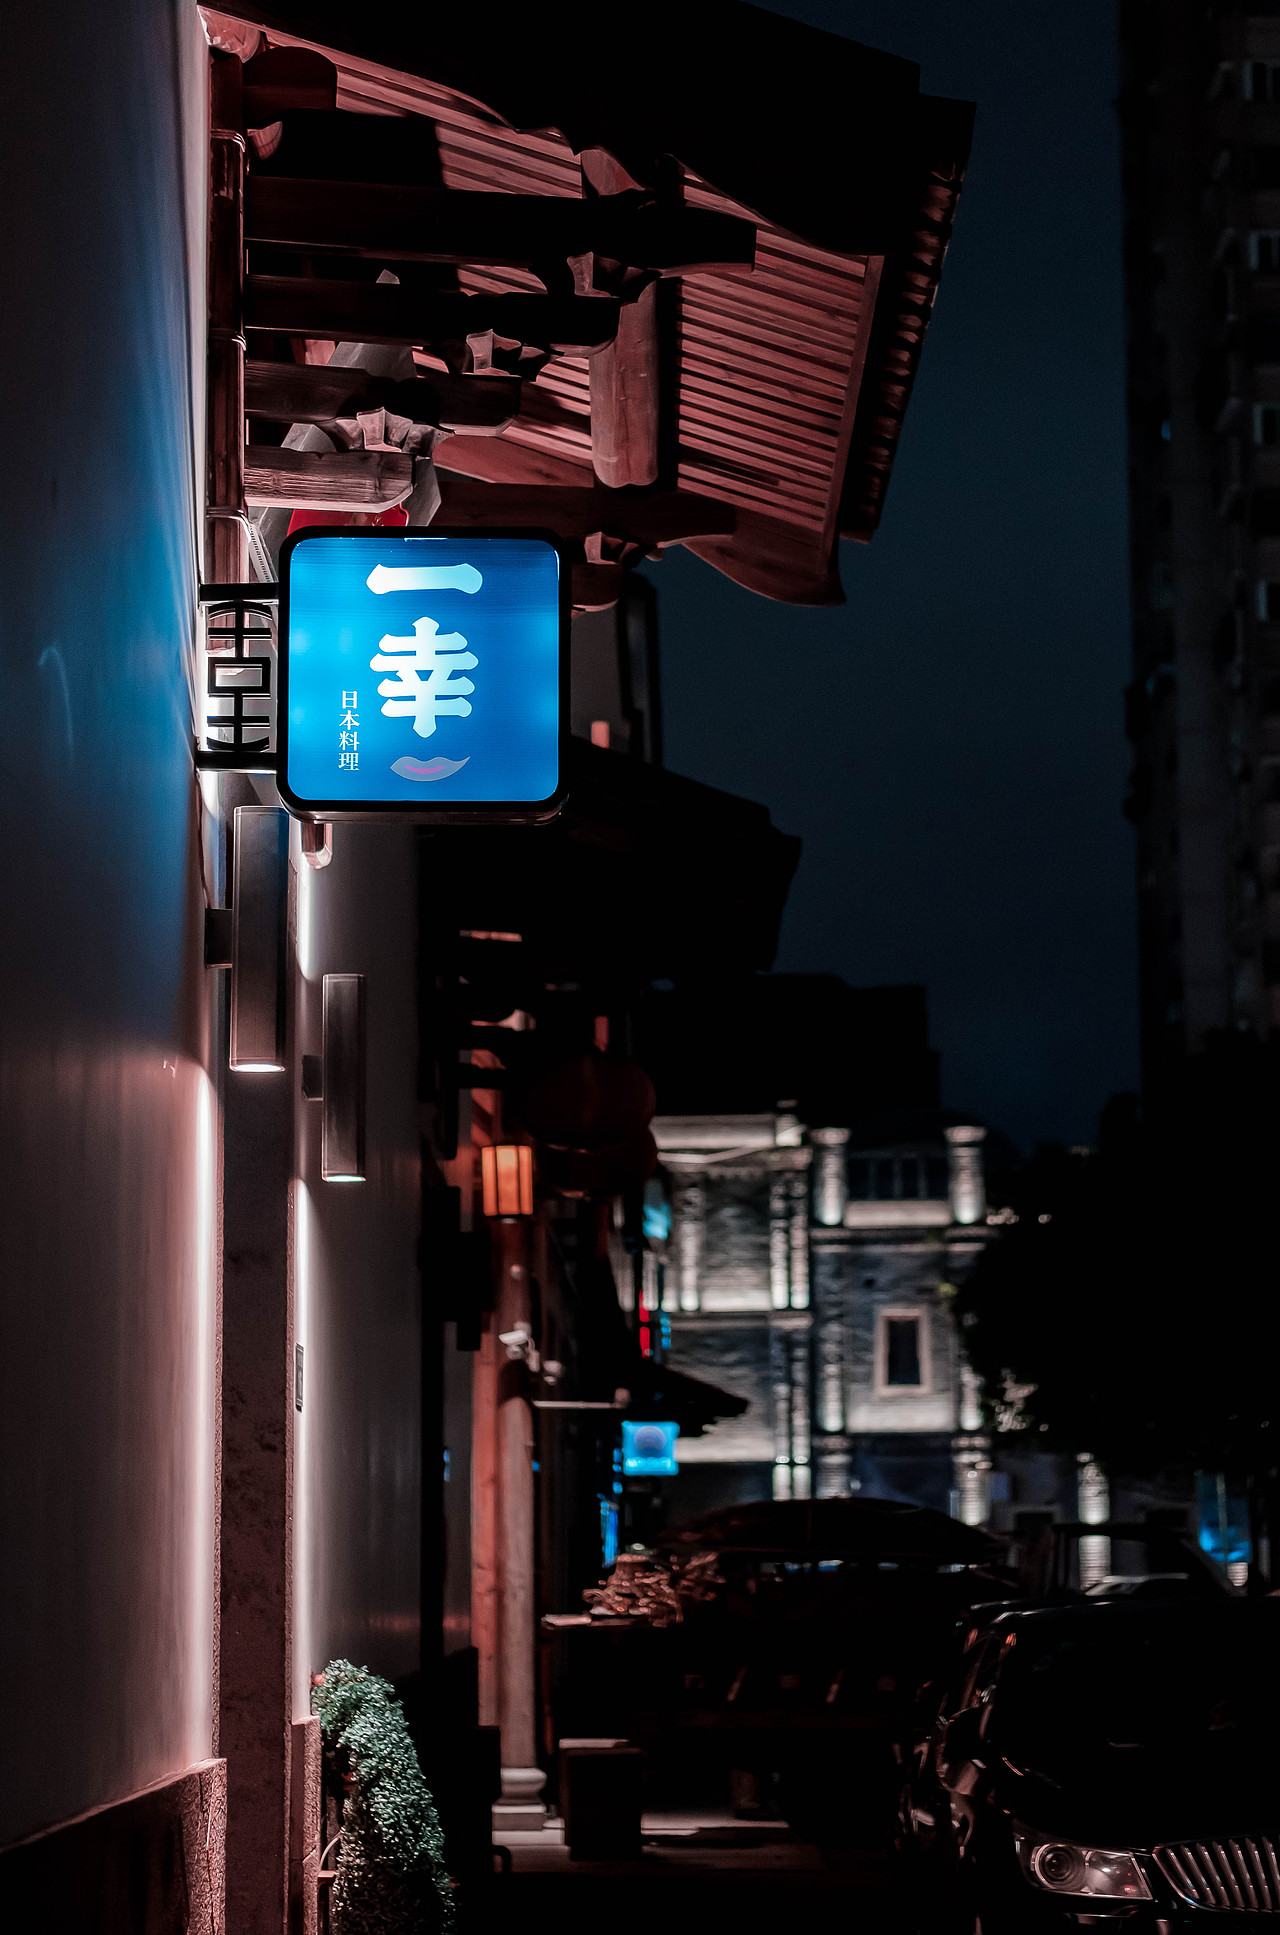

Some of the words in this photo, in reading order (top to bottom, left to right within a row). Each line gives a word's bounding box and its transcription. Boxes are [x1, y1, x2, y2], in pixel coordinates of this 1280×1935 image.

[366, 563, 483, 738] 一幸
[338, 690, 360, 772] 日本料理
